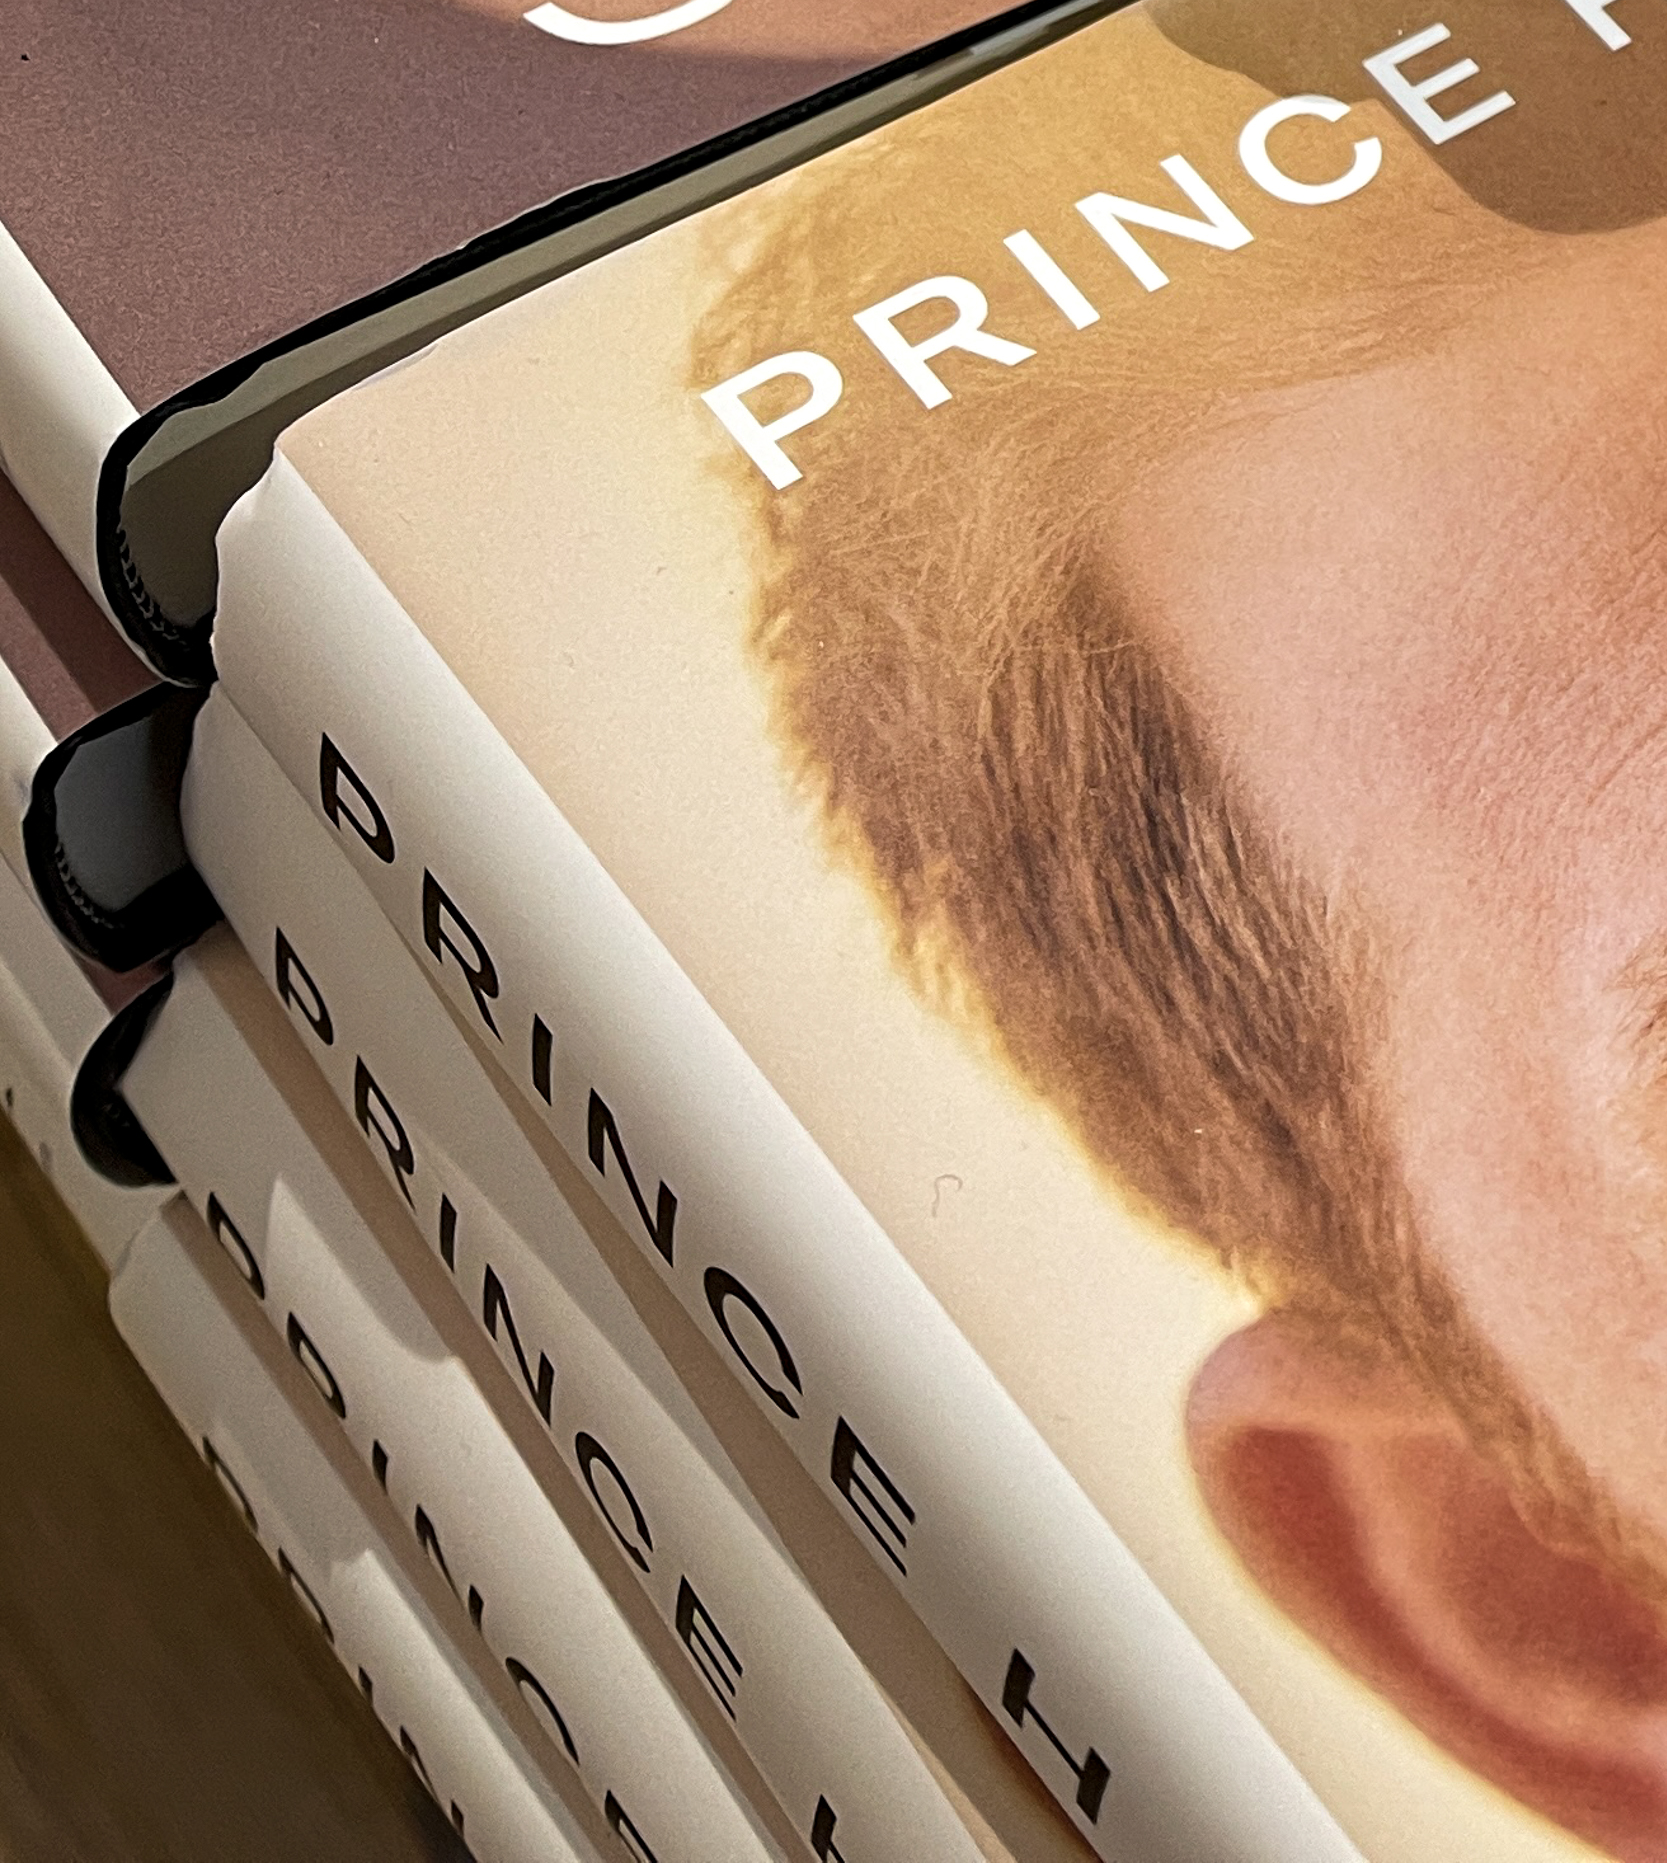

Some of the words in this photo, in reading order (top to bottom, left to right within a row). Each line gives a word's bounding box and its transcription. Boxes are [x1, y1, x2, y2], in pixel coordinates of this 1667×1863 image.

[699, 24, 1516, 490] PRINCE
[274, 927, 744, 1722] PRINCE
[319, 732, 917, 1578] PRINCE
